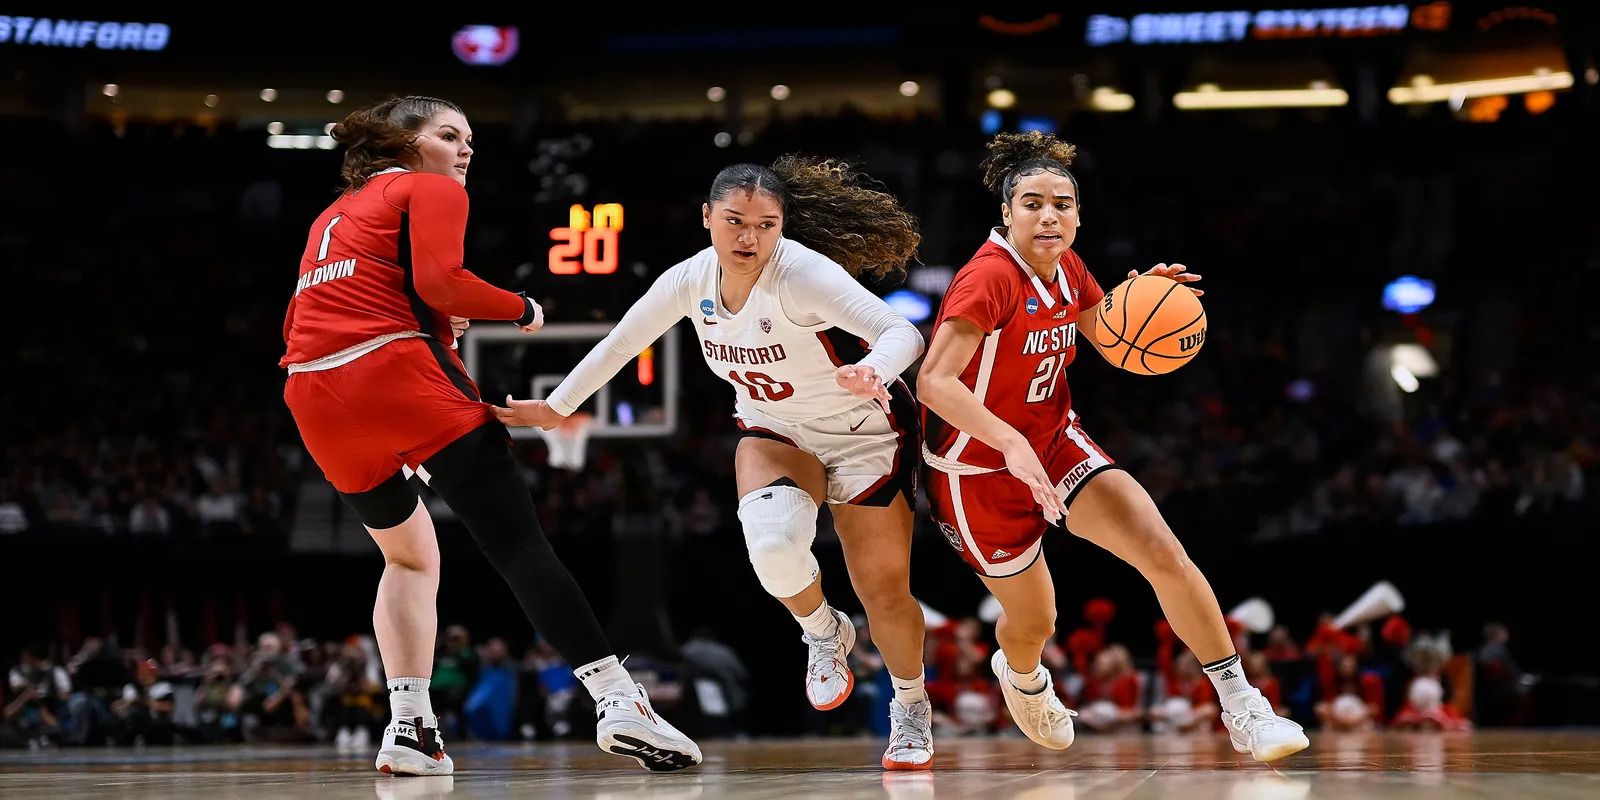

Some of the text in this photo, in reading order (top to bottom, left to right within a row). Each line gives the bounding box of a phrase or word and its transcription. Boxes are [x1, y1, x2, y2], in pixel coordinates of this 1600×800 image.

[0, 15, 170, 50] STANFORD
[317, 214, 342, 262] 1
[549, 227, 619, 274] 20
[704, 340, 787, 365] STANFORD
[1022, 329, 1049, 355] NC
[728, 370, 795, 402] 10
[1026, 352, 1066, 403] 21
[1062, 461, 1093, 491] PACK
